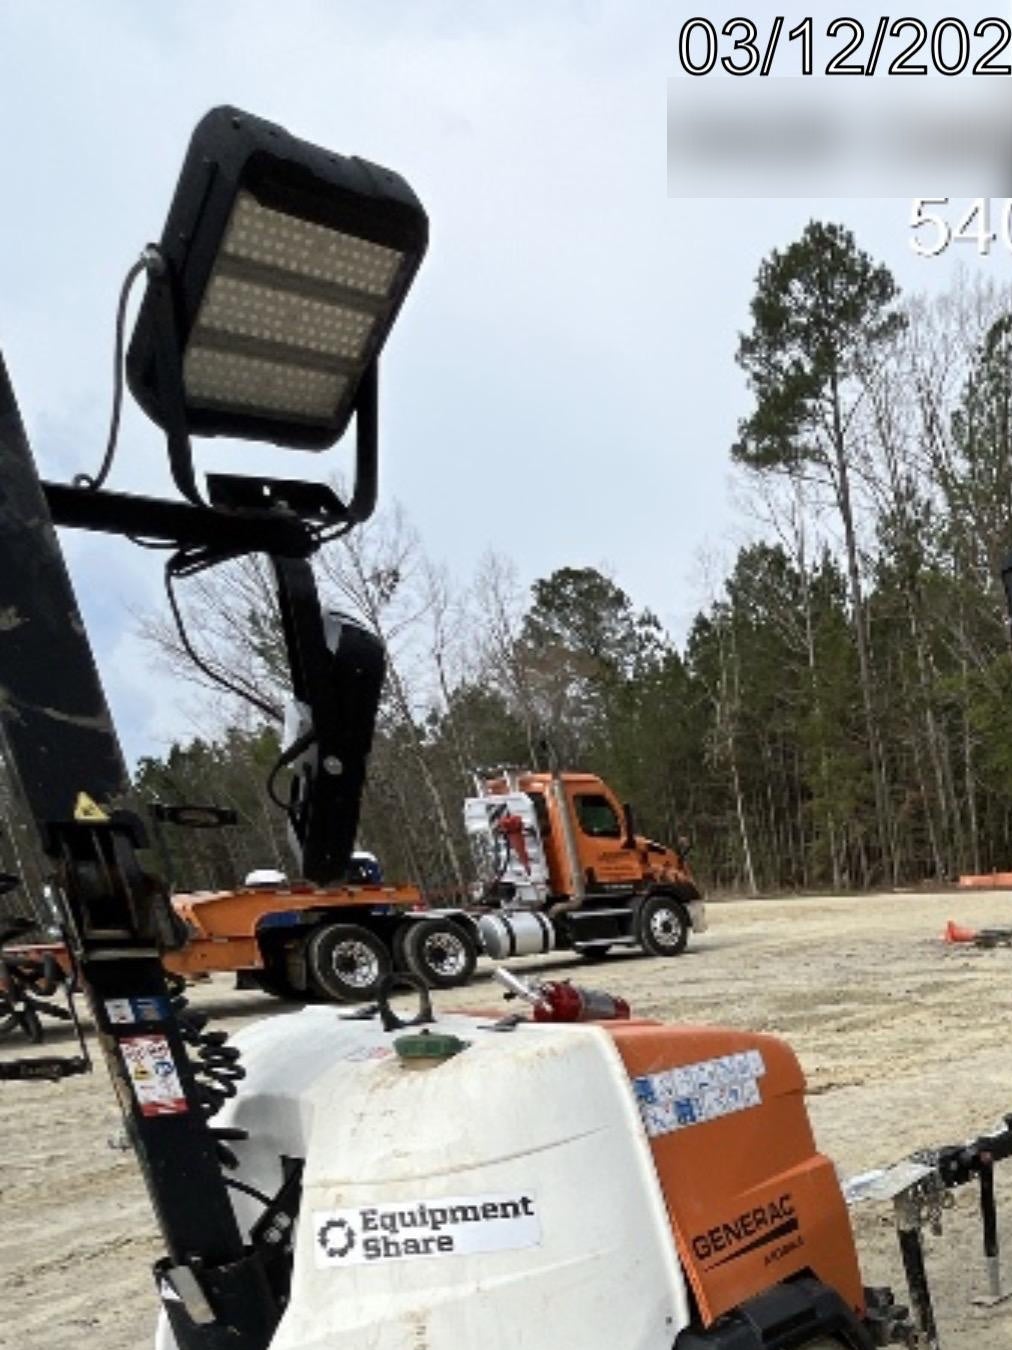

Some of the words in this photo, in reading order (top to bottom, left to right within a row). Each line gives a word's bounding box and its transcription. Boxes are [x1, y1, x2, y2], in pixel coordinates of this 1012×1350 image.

[360, 1196, 535, 1233] Equipment
[692, 1193, 796, 1260] GENERAC
[362, 1234, 454, 1260] Share
